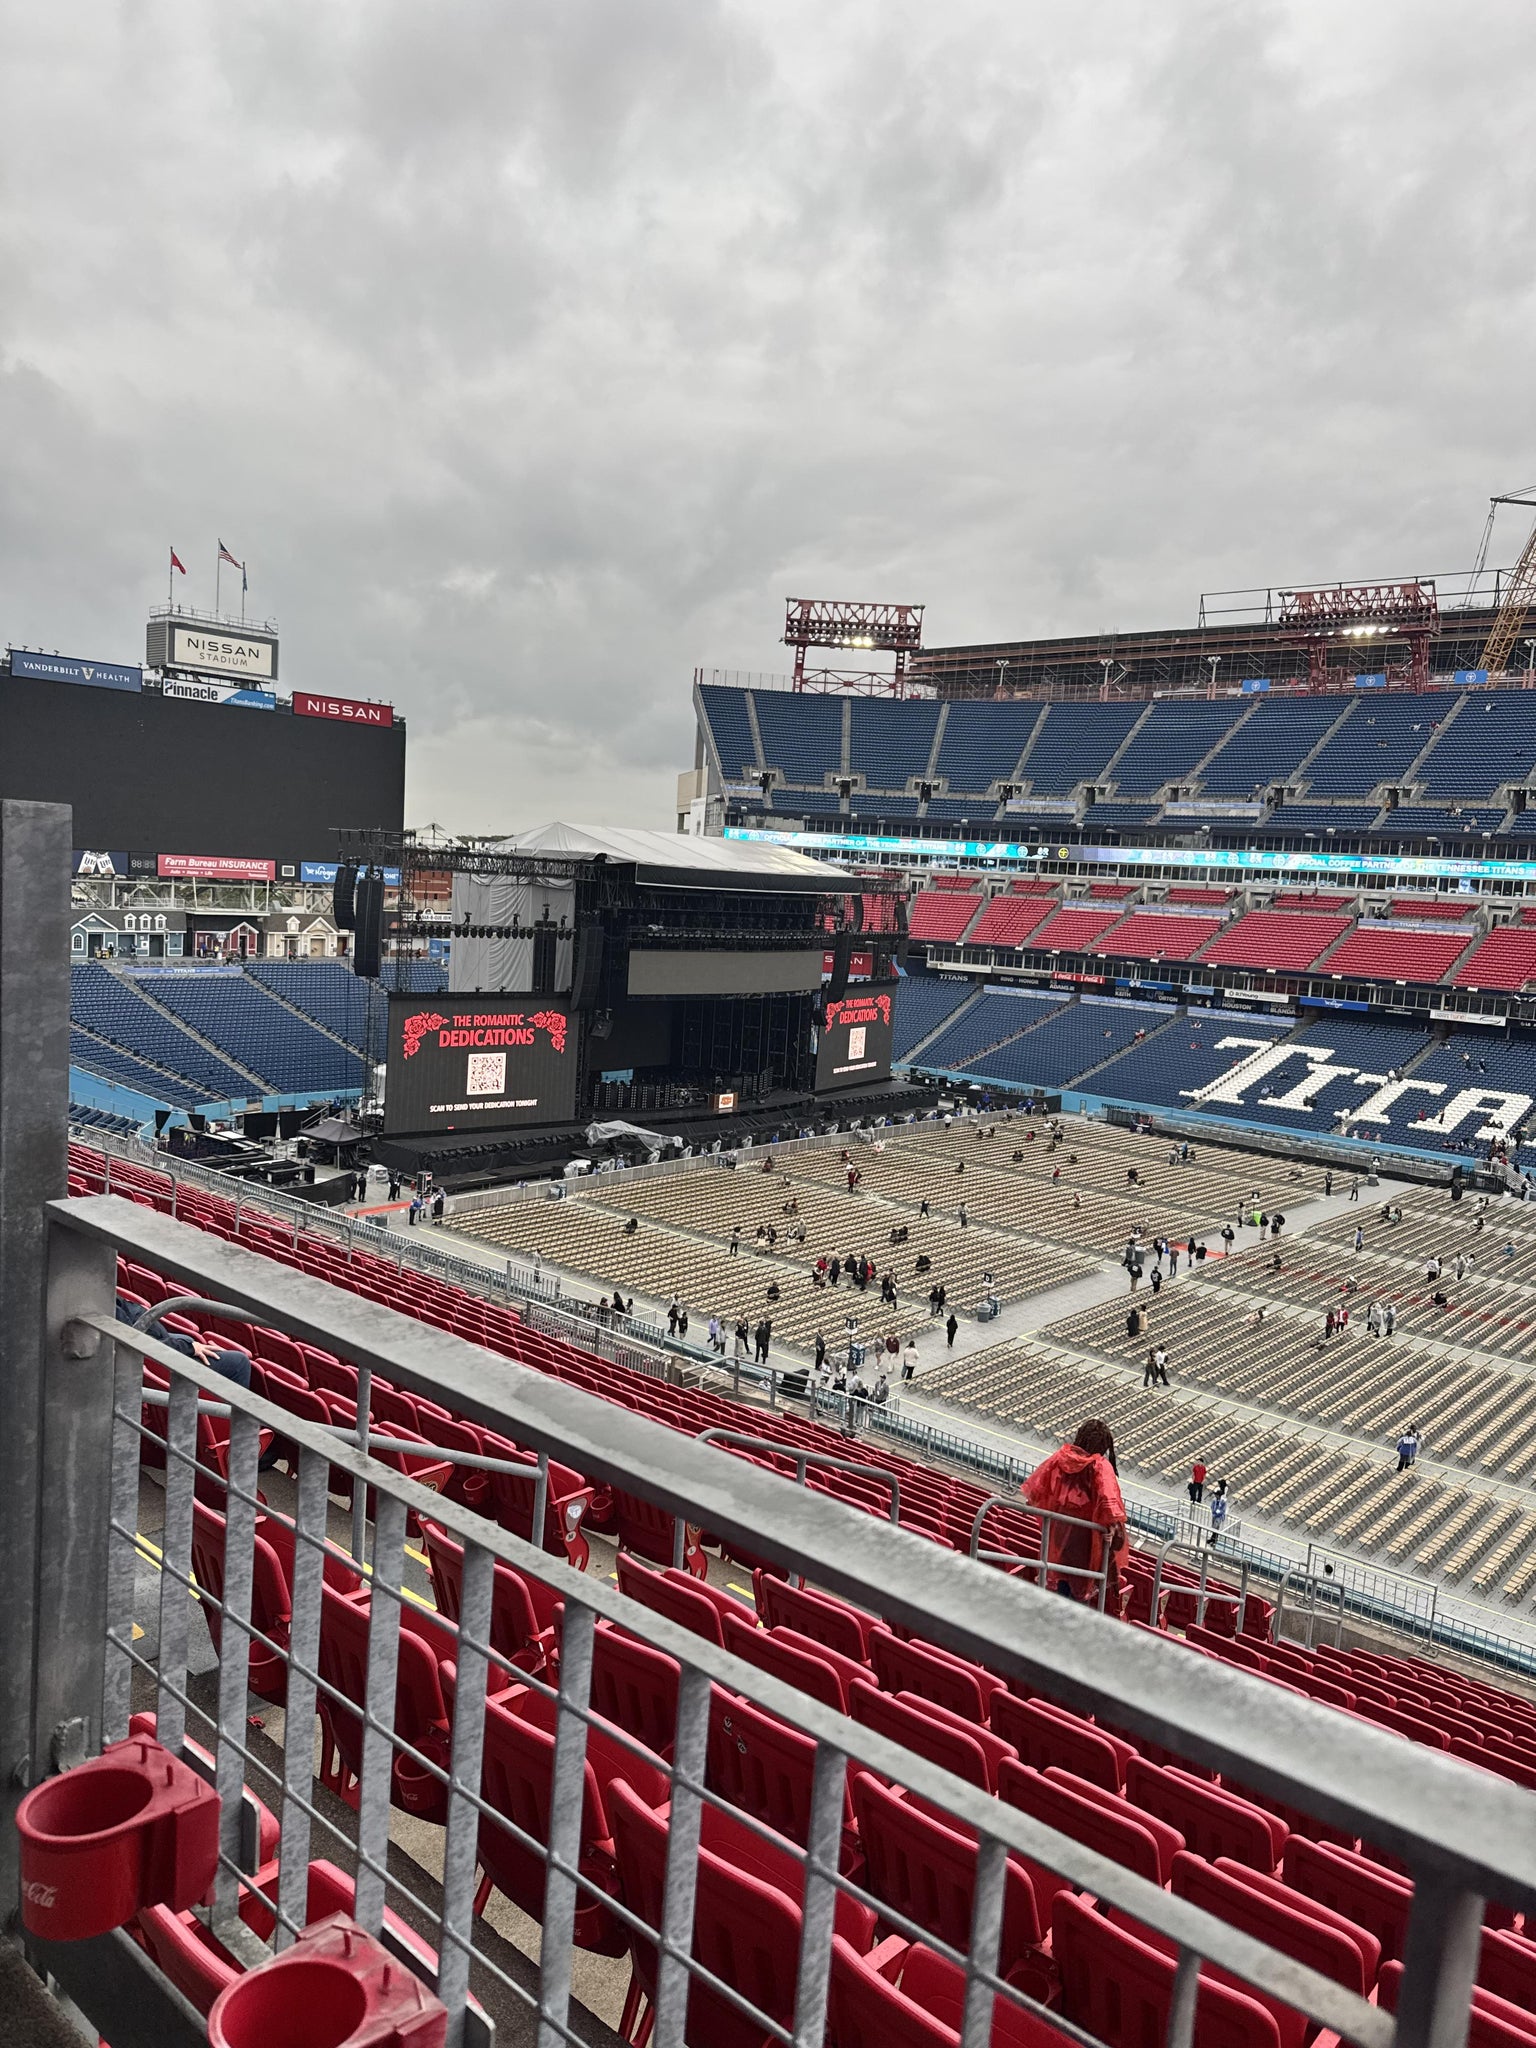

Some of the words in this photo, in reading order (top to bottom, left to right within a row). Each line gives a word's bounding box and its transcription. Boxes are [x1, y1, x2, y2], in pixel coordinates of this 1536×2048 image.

[187, 638, 260, 658] NISSAN
[199, 652, 248, 666] STADIUM
[23, 661, 80, 676] VANDERBILT
[96, 672, 130, 683] HEALTH
[164, 681, 218, 701] Pinnacle
[307, 699, 380, 720] NISSAN
[822, 838, 854, 846] PARTNER
[866, 840, 880, 848] THE
[164, 857, 186, 867] Farm
[188, 859, 217, 868] Bureau
[218, 860, 268, 870] INSURANCE
[1328, 858, 1361, 868] COFFEE
[1362, 860, 1401, 870] PARTNER
[1403, 861, 1415, 870] OF
[1416, 862, 1434, 871] THE
[1436, 863, 1490, 873] TENNESSEE
[1491, 865, 1525, 875] TITANS
[315, 865, 336, 880] Kroger
[939, 973, 969, 982] TITANS
[1157, 995, 1178, 1003] ORTON
[1222, 1002, 1252, 1010] HOUSTON
[839, 1008, 878, 1025] DEDICATIONS
[1270, 1007, 1296, 1015] BLANDA
[453, 1015, 472, 1027] THE
[473, 1013, 524, 1026] ROMANTIC
[439, 1028, 535, 1048] DEDICATIONS
[1180, 1036, 1536, 1148] TITA
[429, 1105, 445, 1113] SCAN
[454, 1103, 468, 1111] SEND
[469, 1102, 484, 1110] YOUR
[484, 1100, 515, 1109] DEDICATION
[515, 1099, 538, 1107] TONIGHT
